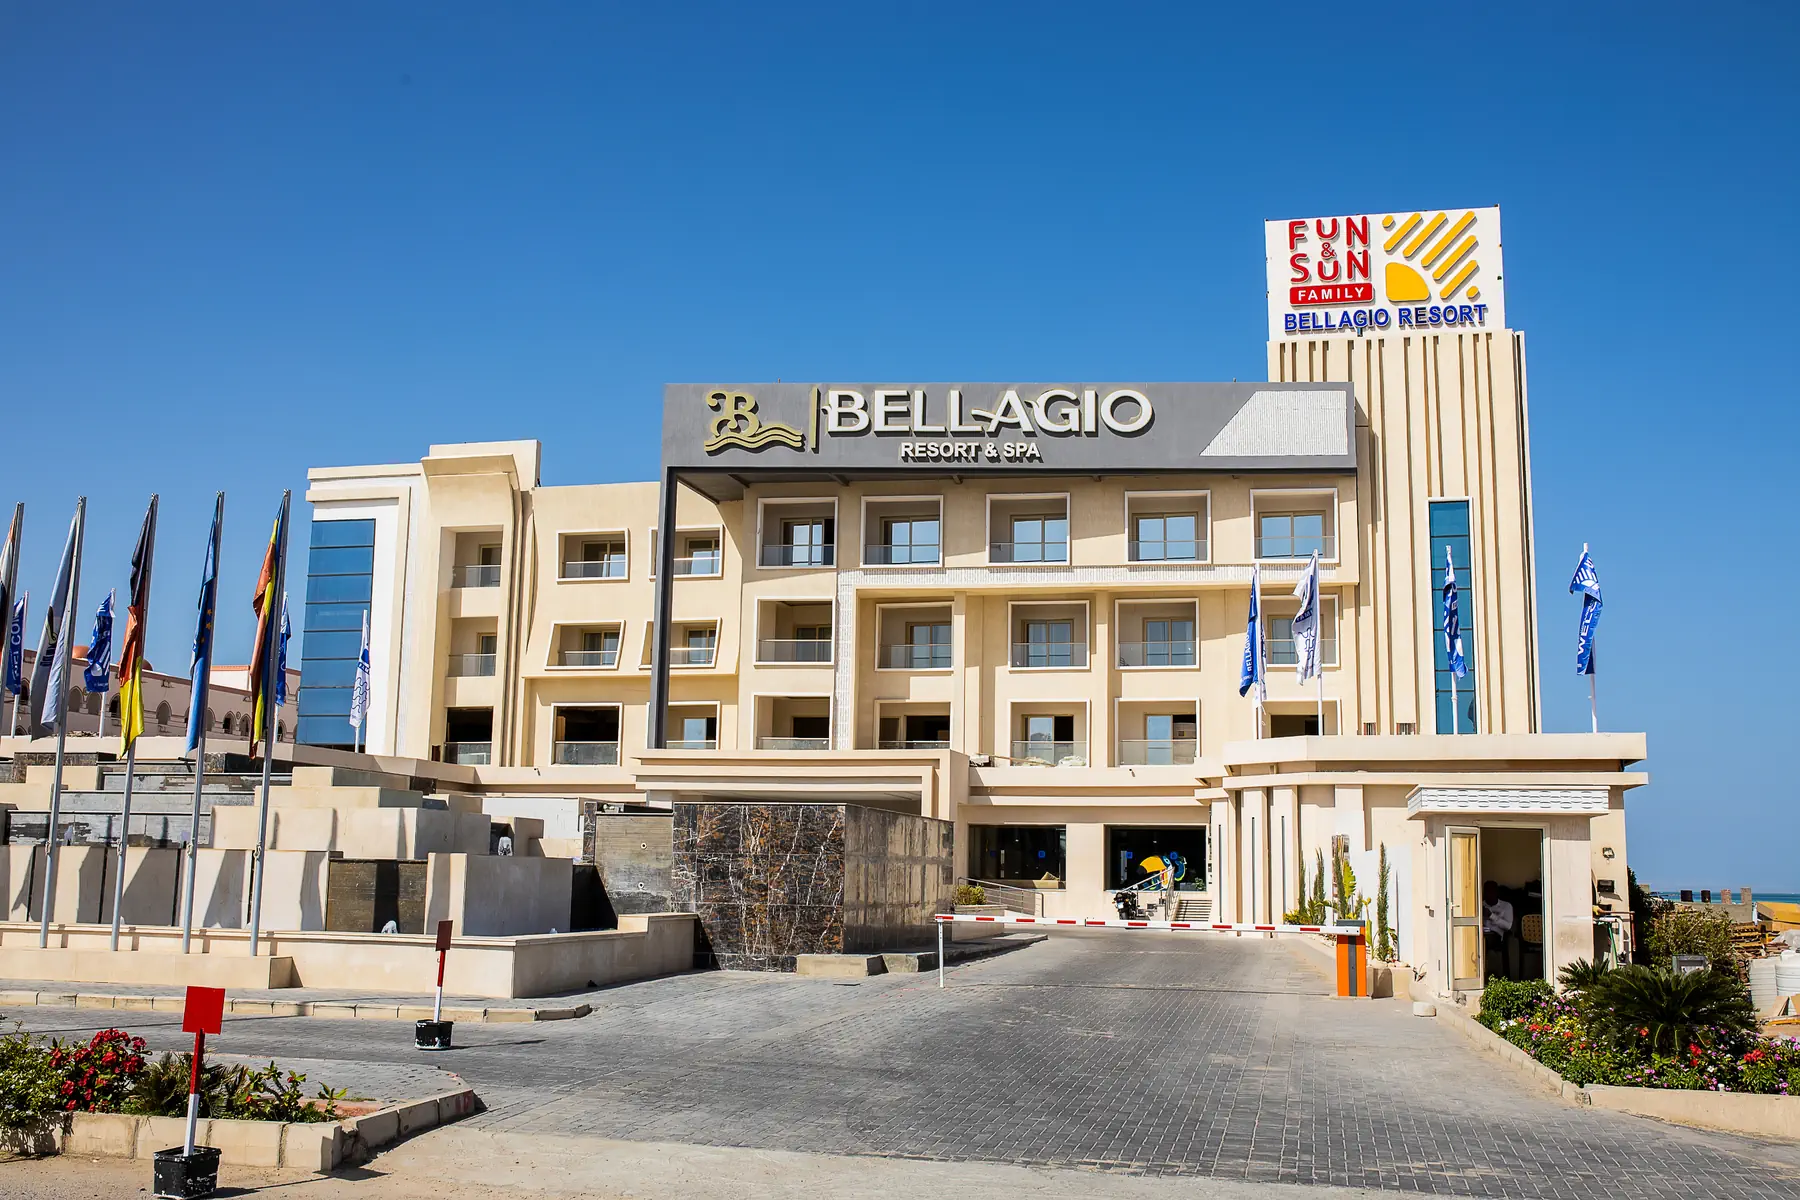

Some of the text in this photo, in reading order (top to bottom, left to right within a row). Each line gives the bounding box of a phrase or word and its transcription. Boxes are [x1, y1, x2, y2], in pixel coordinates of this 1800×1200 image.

[1288, 215, 1370, 251] FUN
[1320, 242, 1338, 259] &
[1290, 249, 1371, 284] SUN
[1298, 286, 1365, 301] FAMILY
[1284, 303, 1487, 332] BELLAGIO RESORT
[821, 388, 1154, 434] BELLAGIO
[900, 441, 1042, 459] RESORT & SPA
